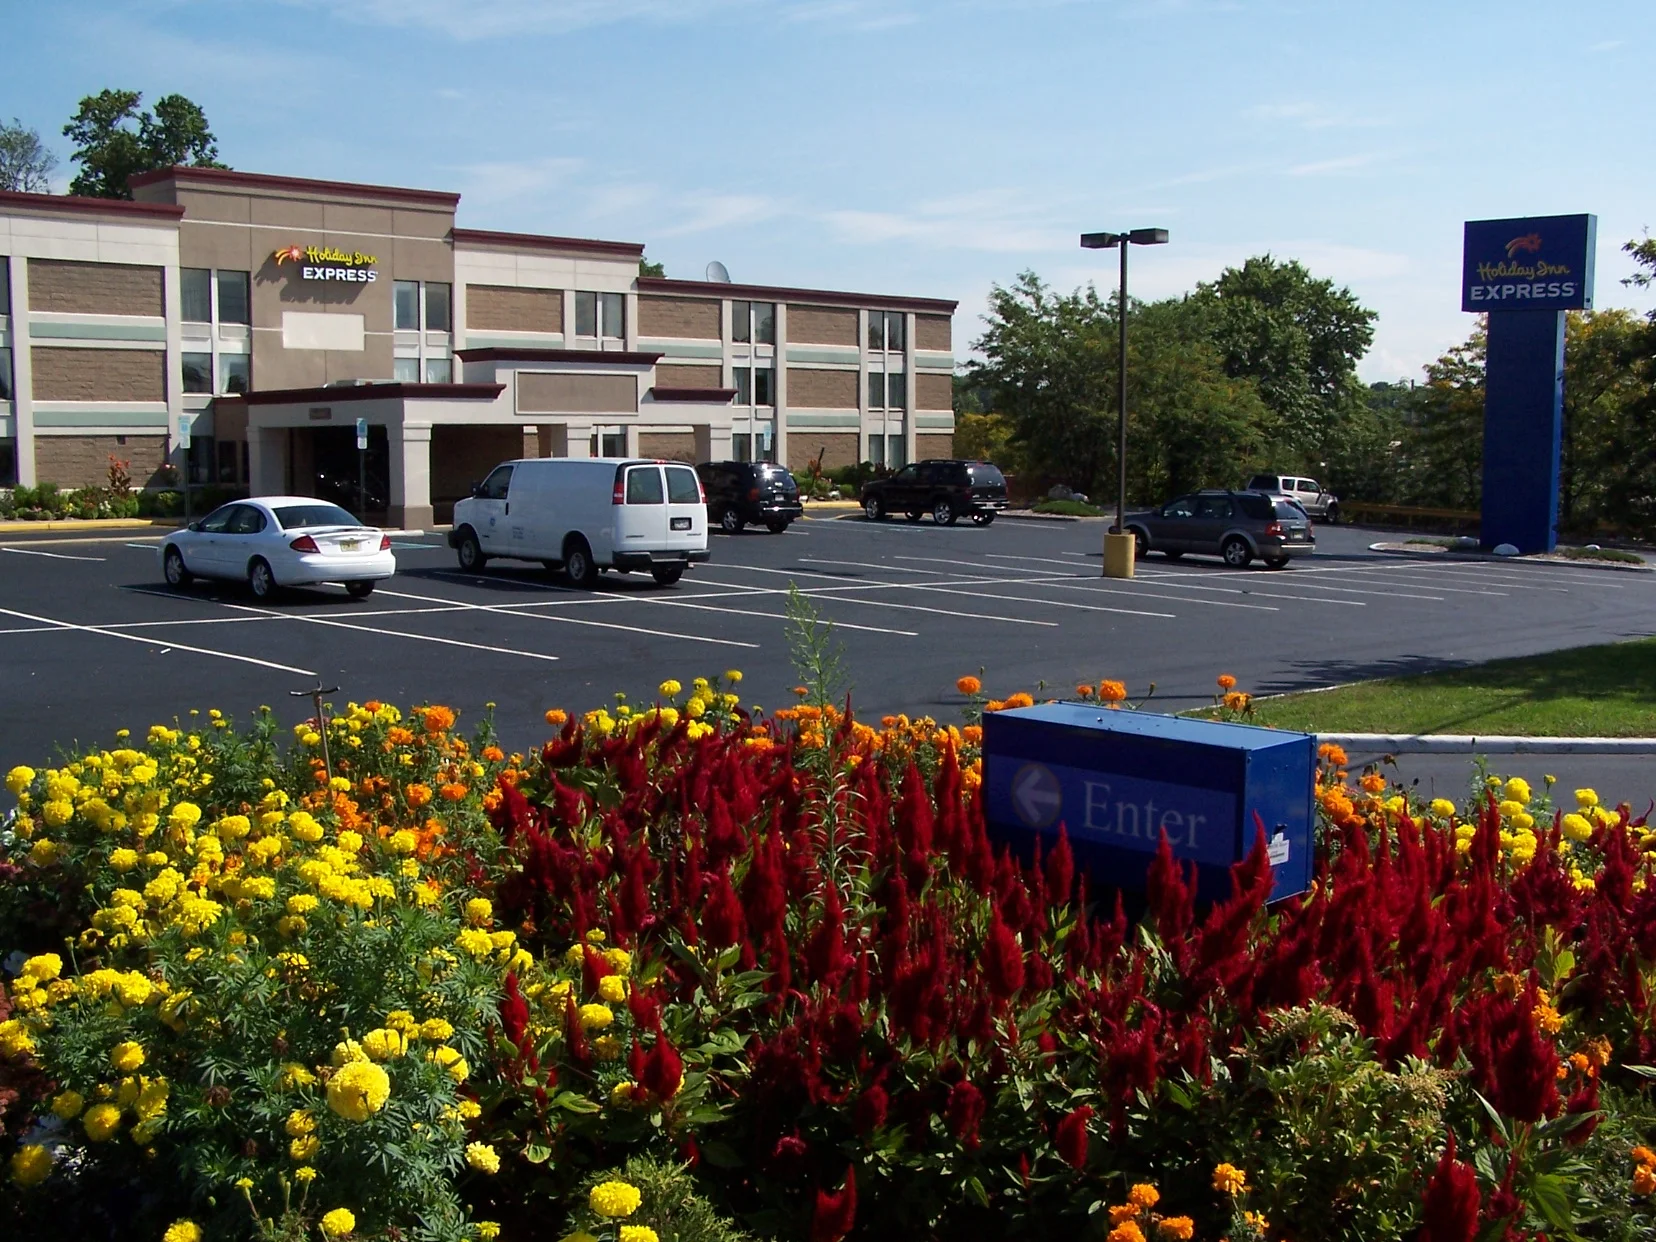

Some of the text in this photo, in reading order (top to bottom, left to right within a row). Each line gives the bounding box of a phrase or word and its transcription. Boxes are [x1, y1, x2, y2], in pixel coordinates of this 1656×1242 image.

[306, 245, 378, 266] Holiday Inn
[303, 267, 377, 282] EXPRESS
[1476, 260, 1570, 281] Holiday Inn
[1471, 282, 1575, 300] EXPRESS
[1083, 780, 1207, 848] Enter
